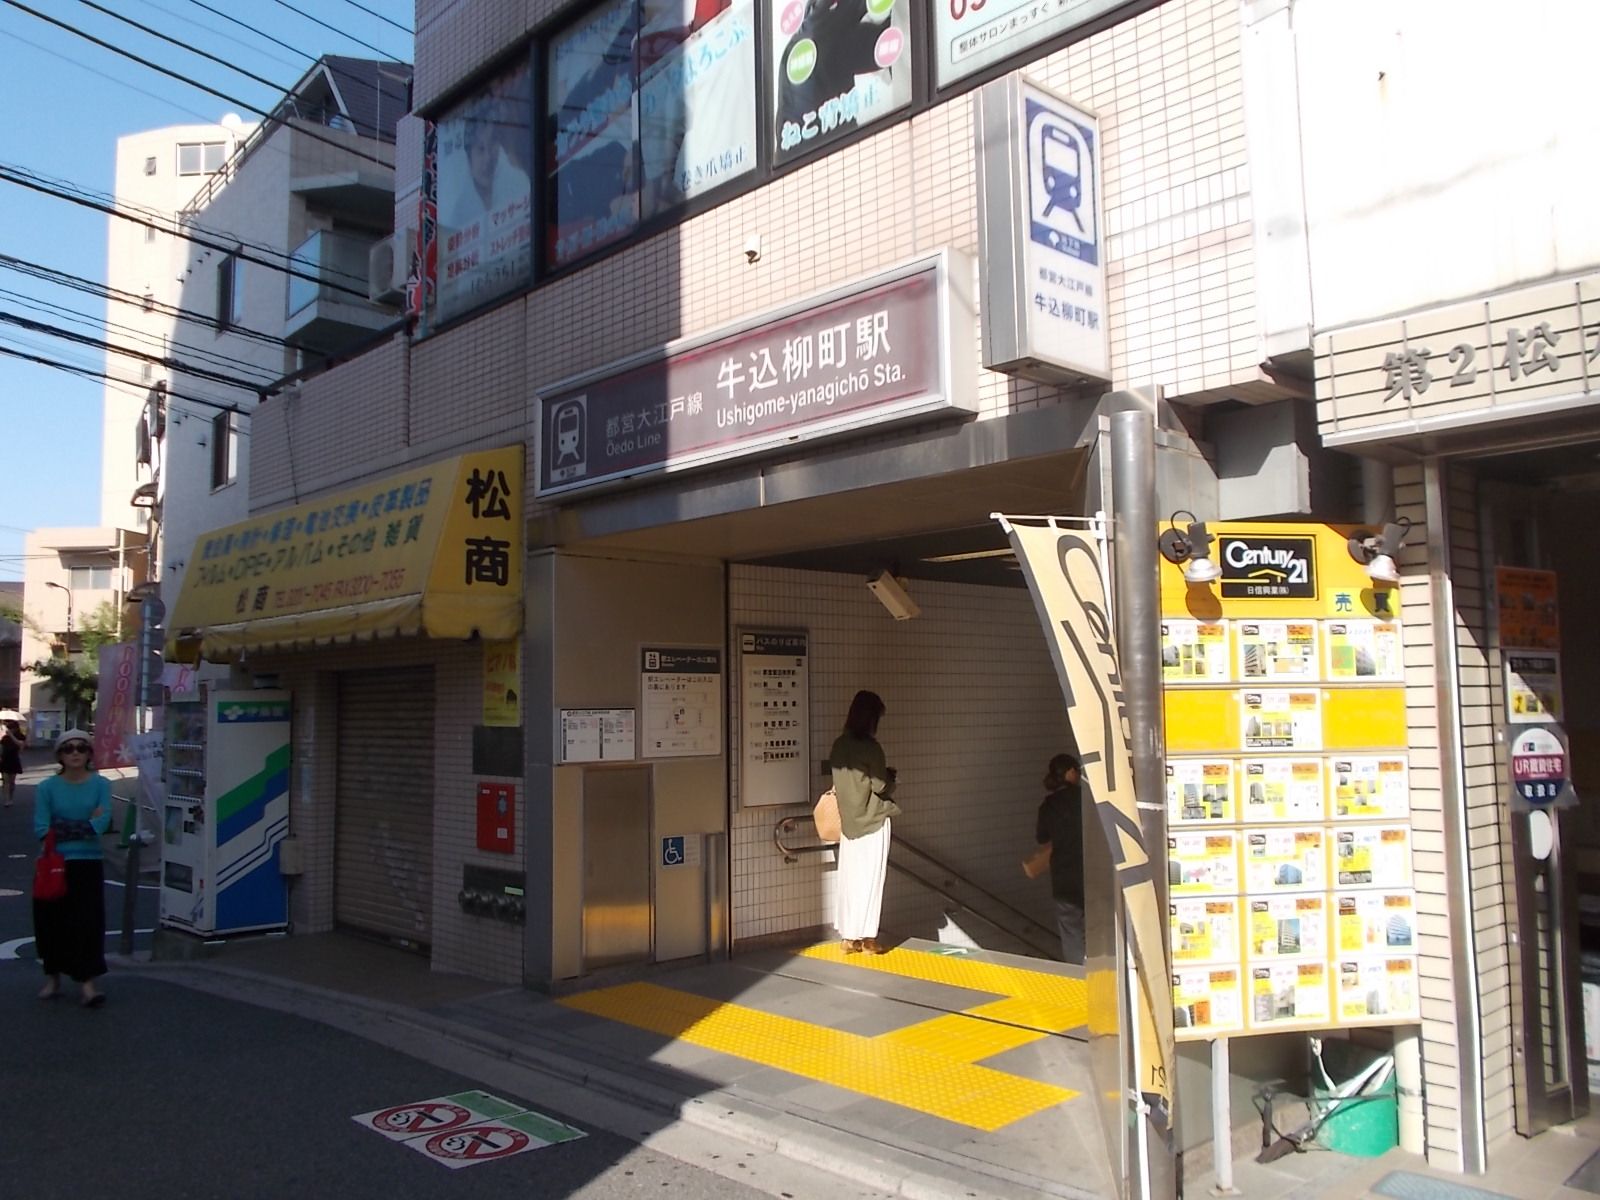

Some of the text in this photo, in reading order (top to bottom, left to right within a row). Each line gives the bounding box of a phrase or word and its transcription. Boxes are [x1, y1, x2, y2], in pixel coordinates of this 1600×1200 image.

[1039, 267, 1093, 297] 都営大江戸線
[1034, 291, 1100, 330] 牛込柳町駅
[717, 310, 891, 400] 牛込柳町駅
[1380, 319, 1600, 403] 第2松
[605, 391, 704, 437] 都営大江戸線
[716, 366, 907, 429] Ushigome-yanagichō Sta.
[637, 432, 662, 451] Line
[464, 468, 512, 586] 松商
[1225, 540, 1308, 583] Century 21
[1335, 592, 1352, 612] 売
